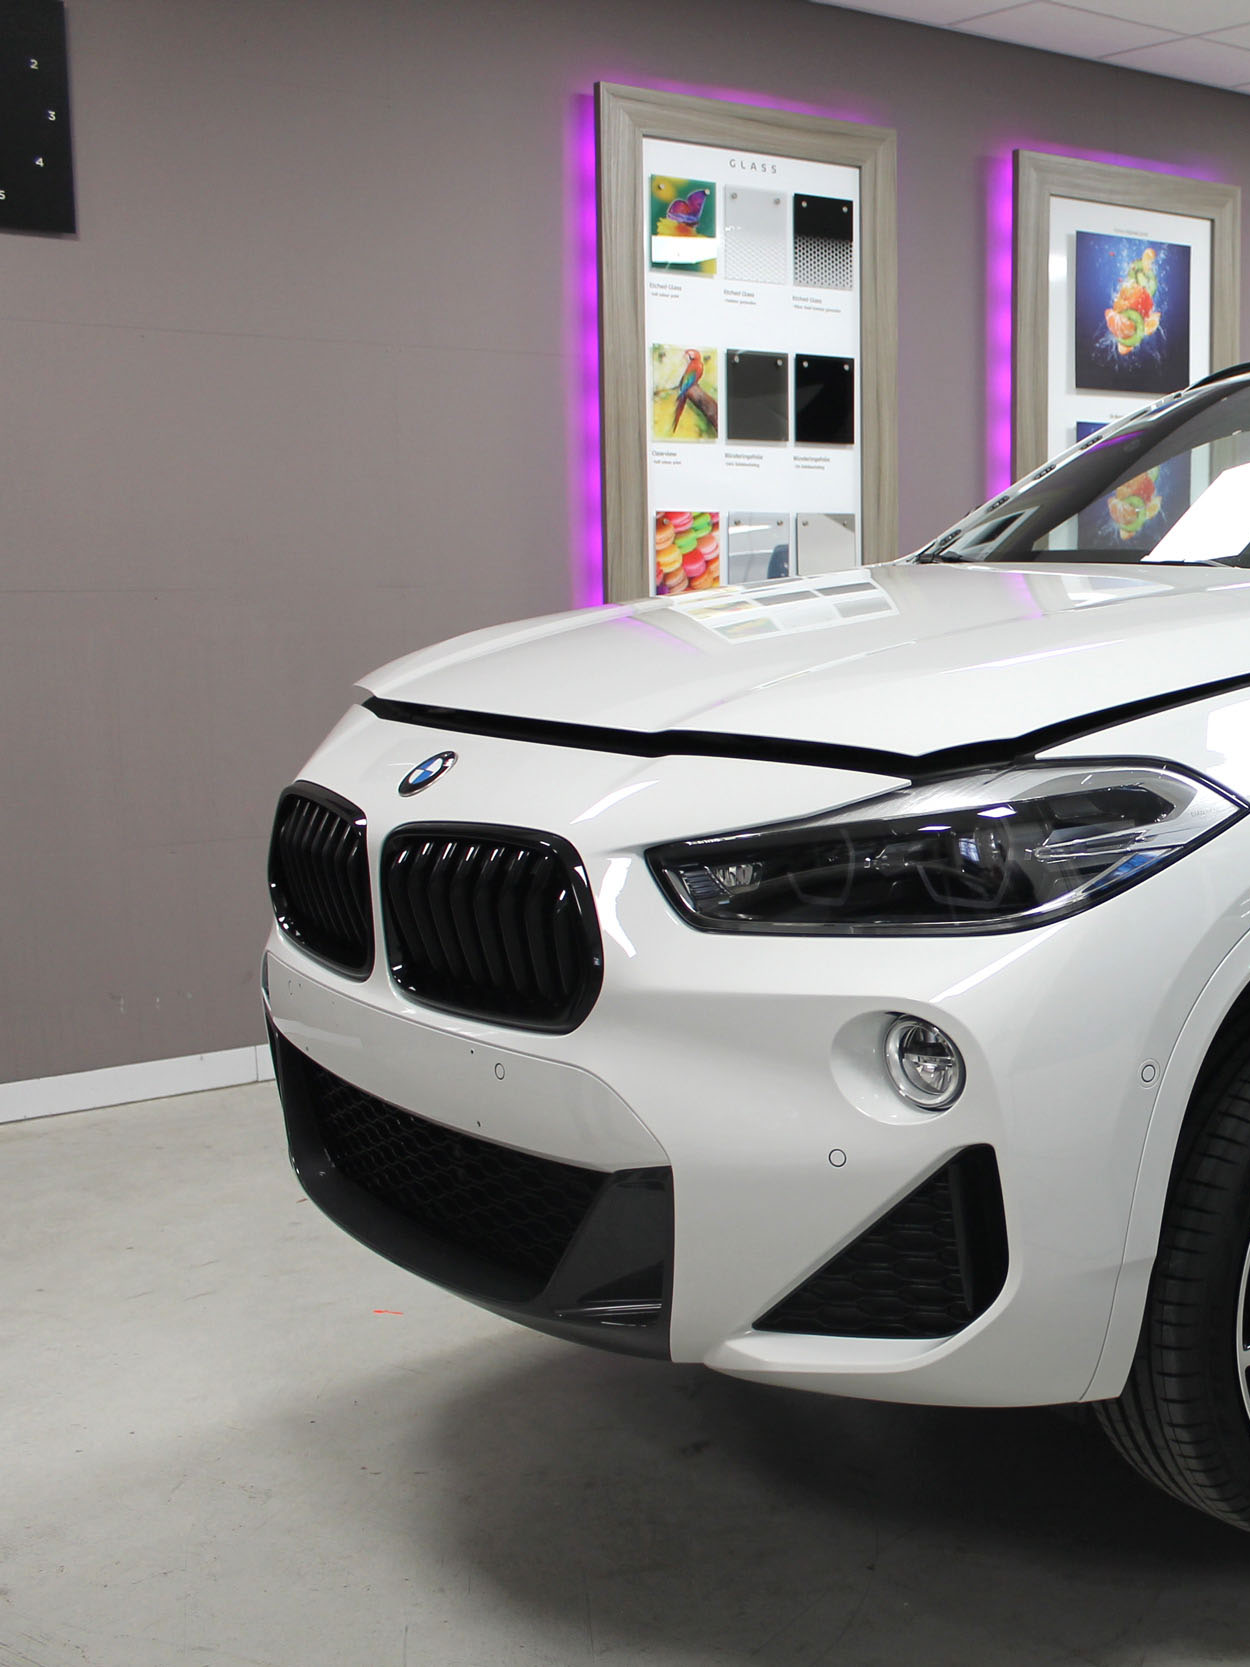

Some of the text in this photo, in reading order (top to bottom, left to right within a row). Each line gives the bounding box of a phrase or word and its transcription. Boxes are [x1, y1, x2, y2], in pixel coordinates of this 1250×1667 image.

[30, 59, 39, 69] 2
[48, 110, 56, 121] 3
[35, 157, 44, 167] 4
[729, 158, 777, 174] GLASS
